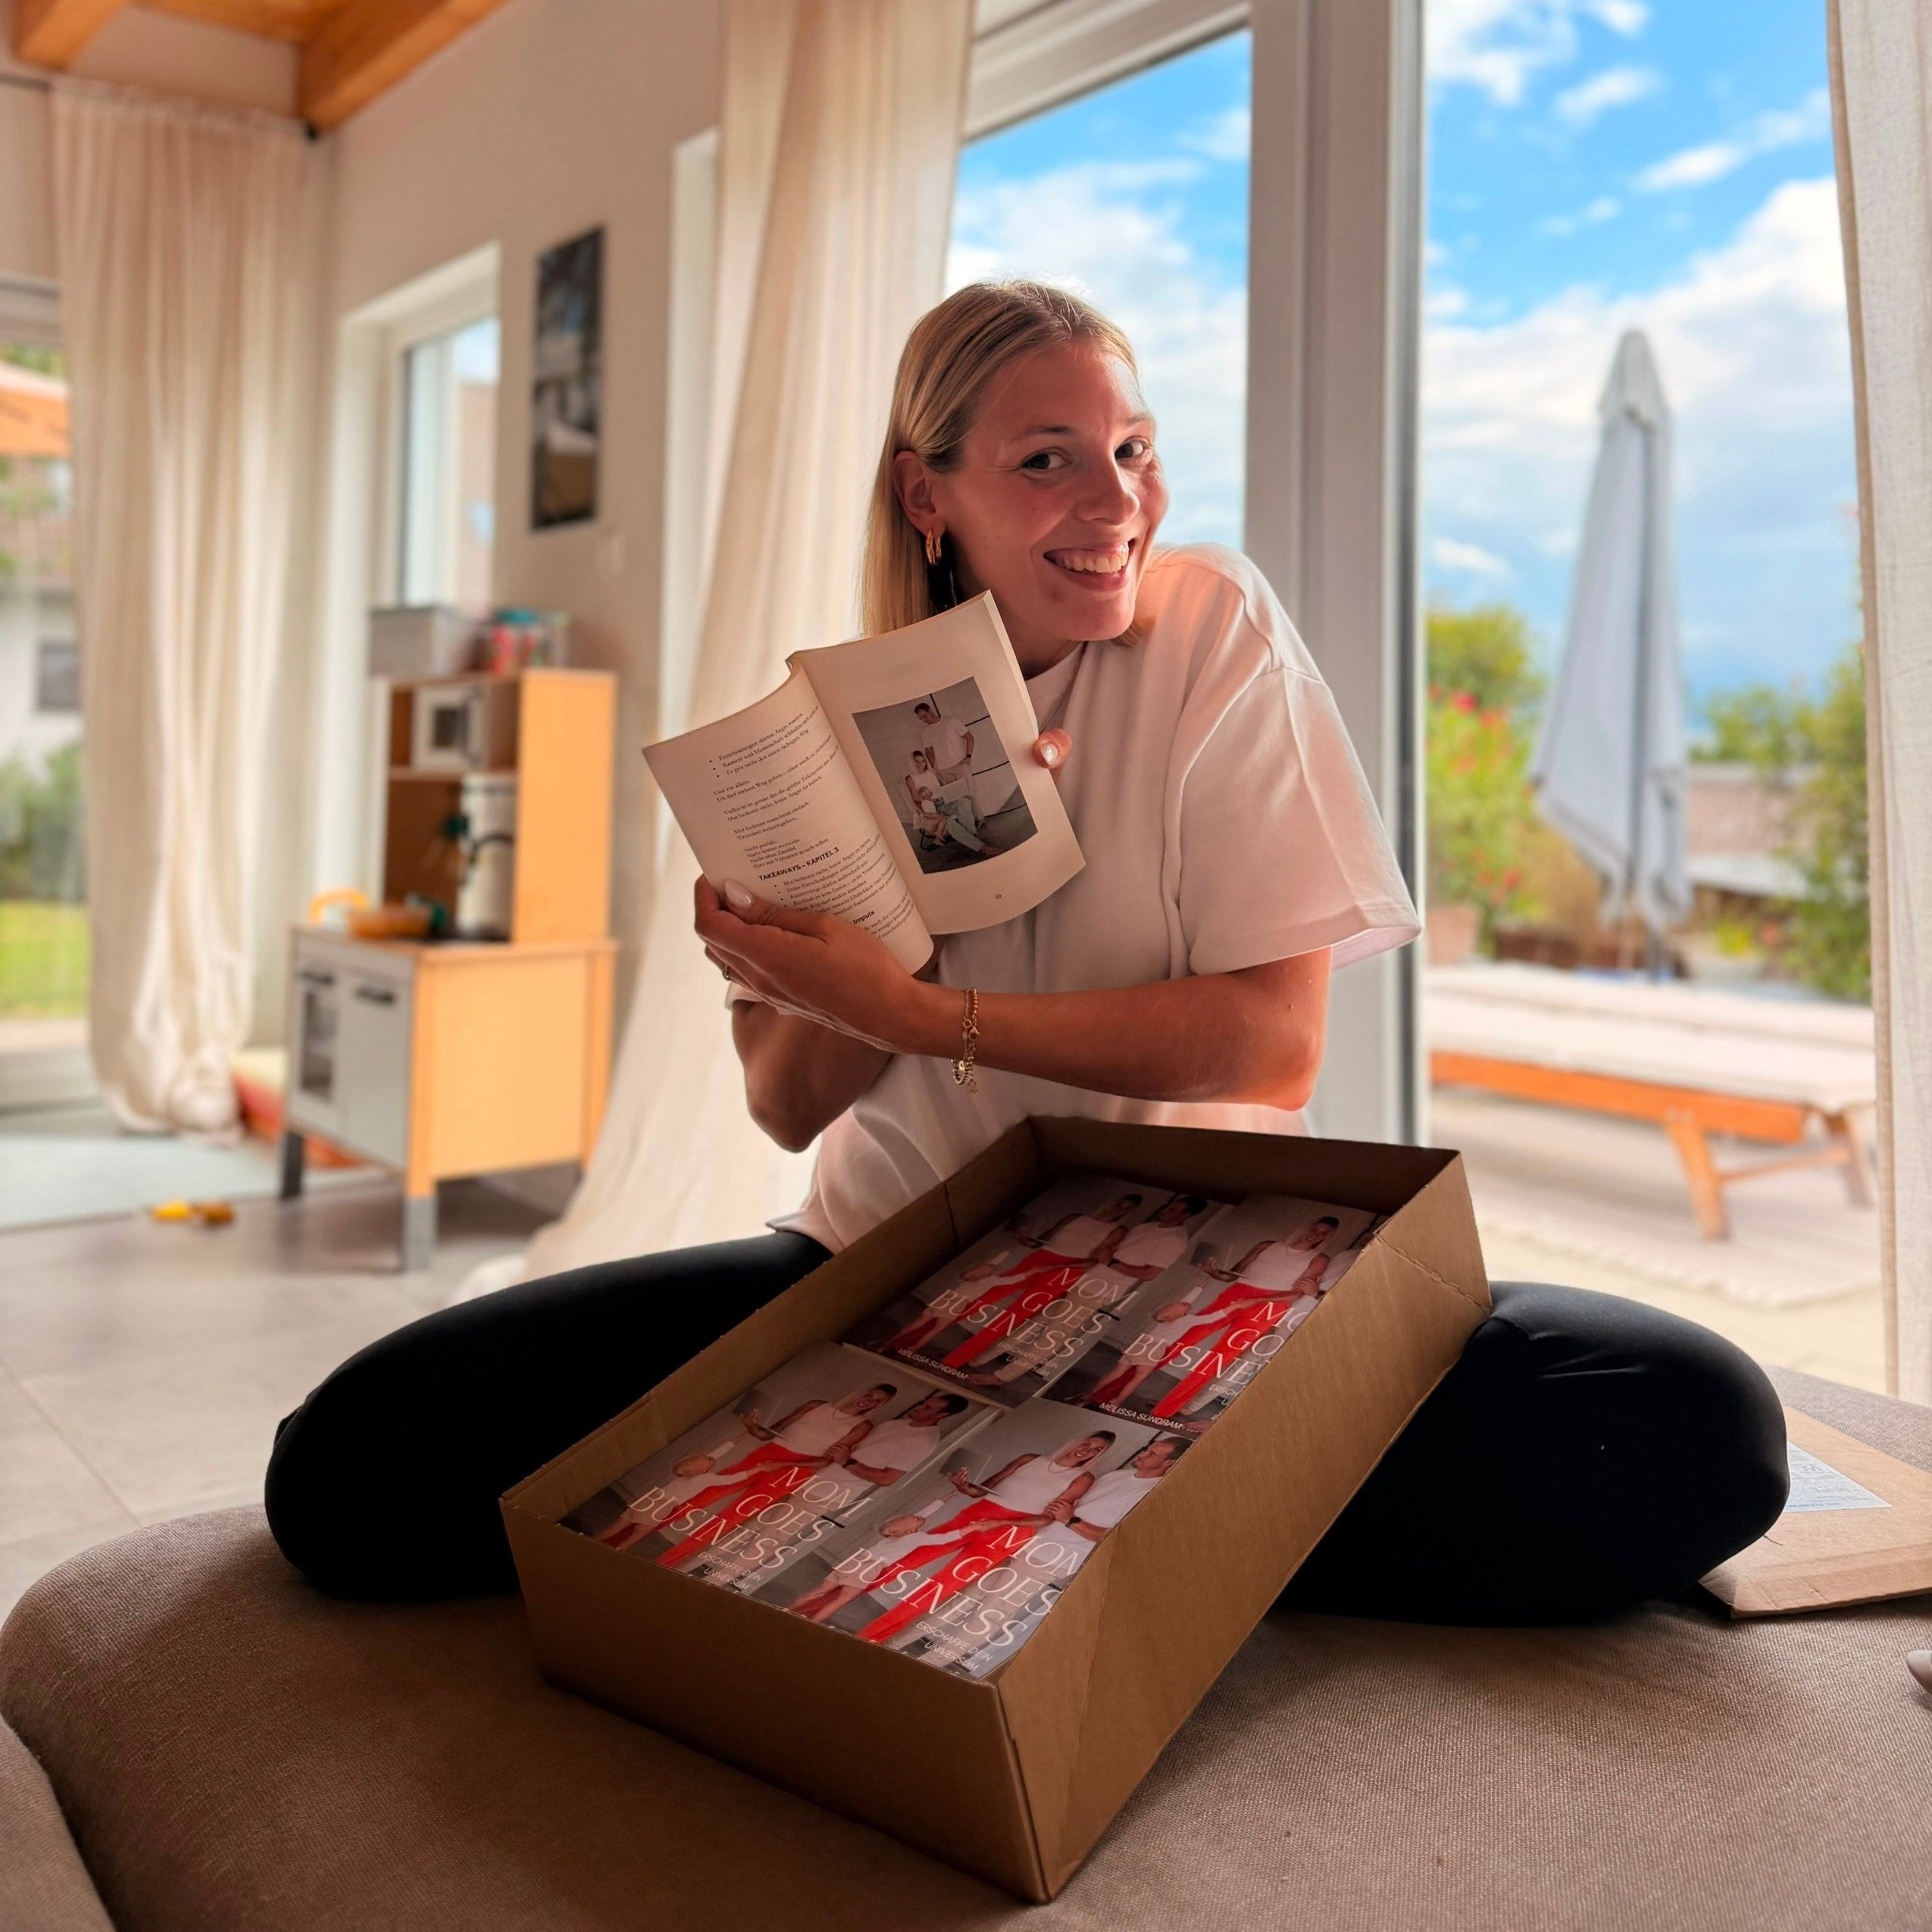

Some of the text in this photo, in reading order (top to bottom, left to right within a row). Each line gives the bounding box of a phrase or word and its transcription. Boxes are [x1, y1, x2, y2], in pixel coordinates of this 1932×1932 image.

[759, 864, 802, 880] TAKEAWAYS
[806, 850, 834, 866] KAPITEL
[852, 911, 875, 924] Impuls
[1047, 1268, 1139, 1311] MOM
[929, 1290, 1085, 1358] BUSINESS
[1021, 1292, 1111, 1333] GOES
[896, 1348, 930, 1364] MELISSA
[1122, 1333, 1267, 1385] BUSINE
[1227, 1328, 1284, 1356] GO
[1099, 1402, 1183, 1430] MELISSA SUNDRAM
[770, 1467, 874, 1519] MOM
[628, 1486, 798, 1568] BUSINESS
[736, 1494, 835, 1541] GOES
[832, 1547, 1028, 1647] BUSINESS
[952, 1556, 1064, 1615] GOES
[916, 1621, 993, 1661] ERSCHAFFE DEIN
[924, 1641, 980, 1671] UNIVERSUM
